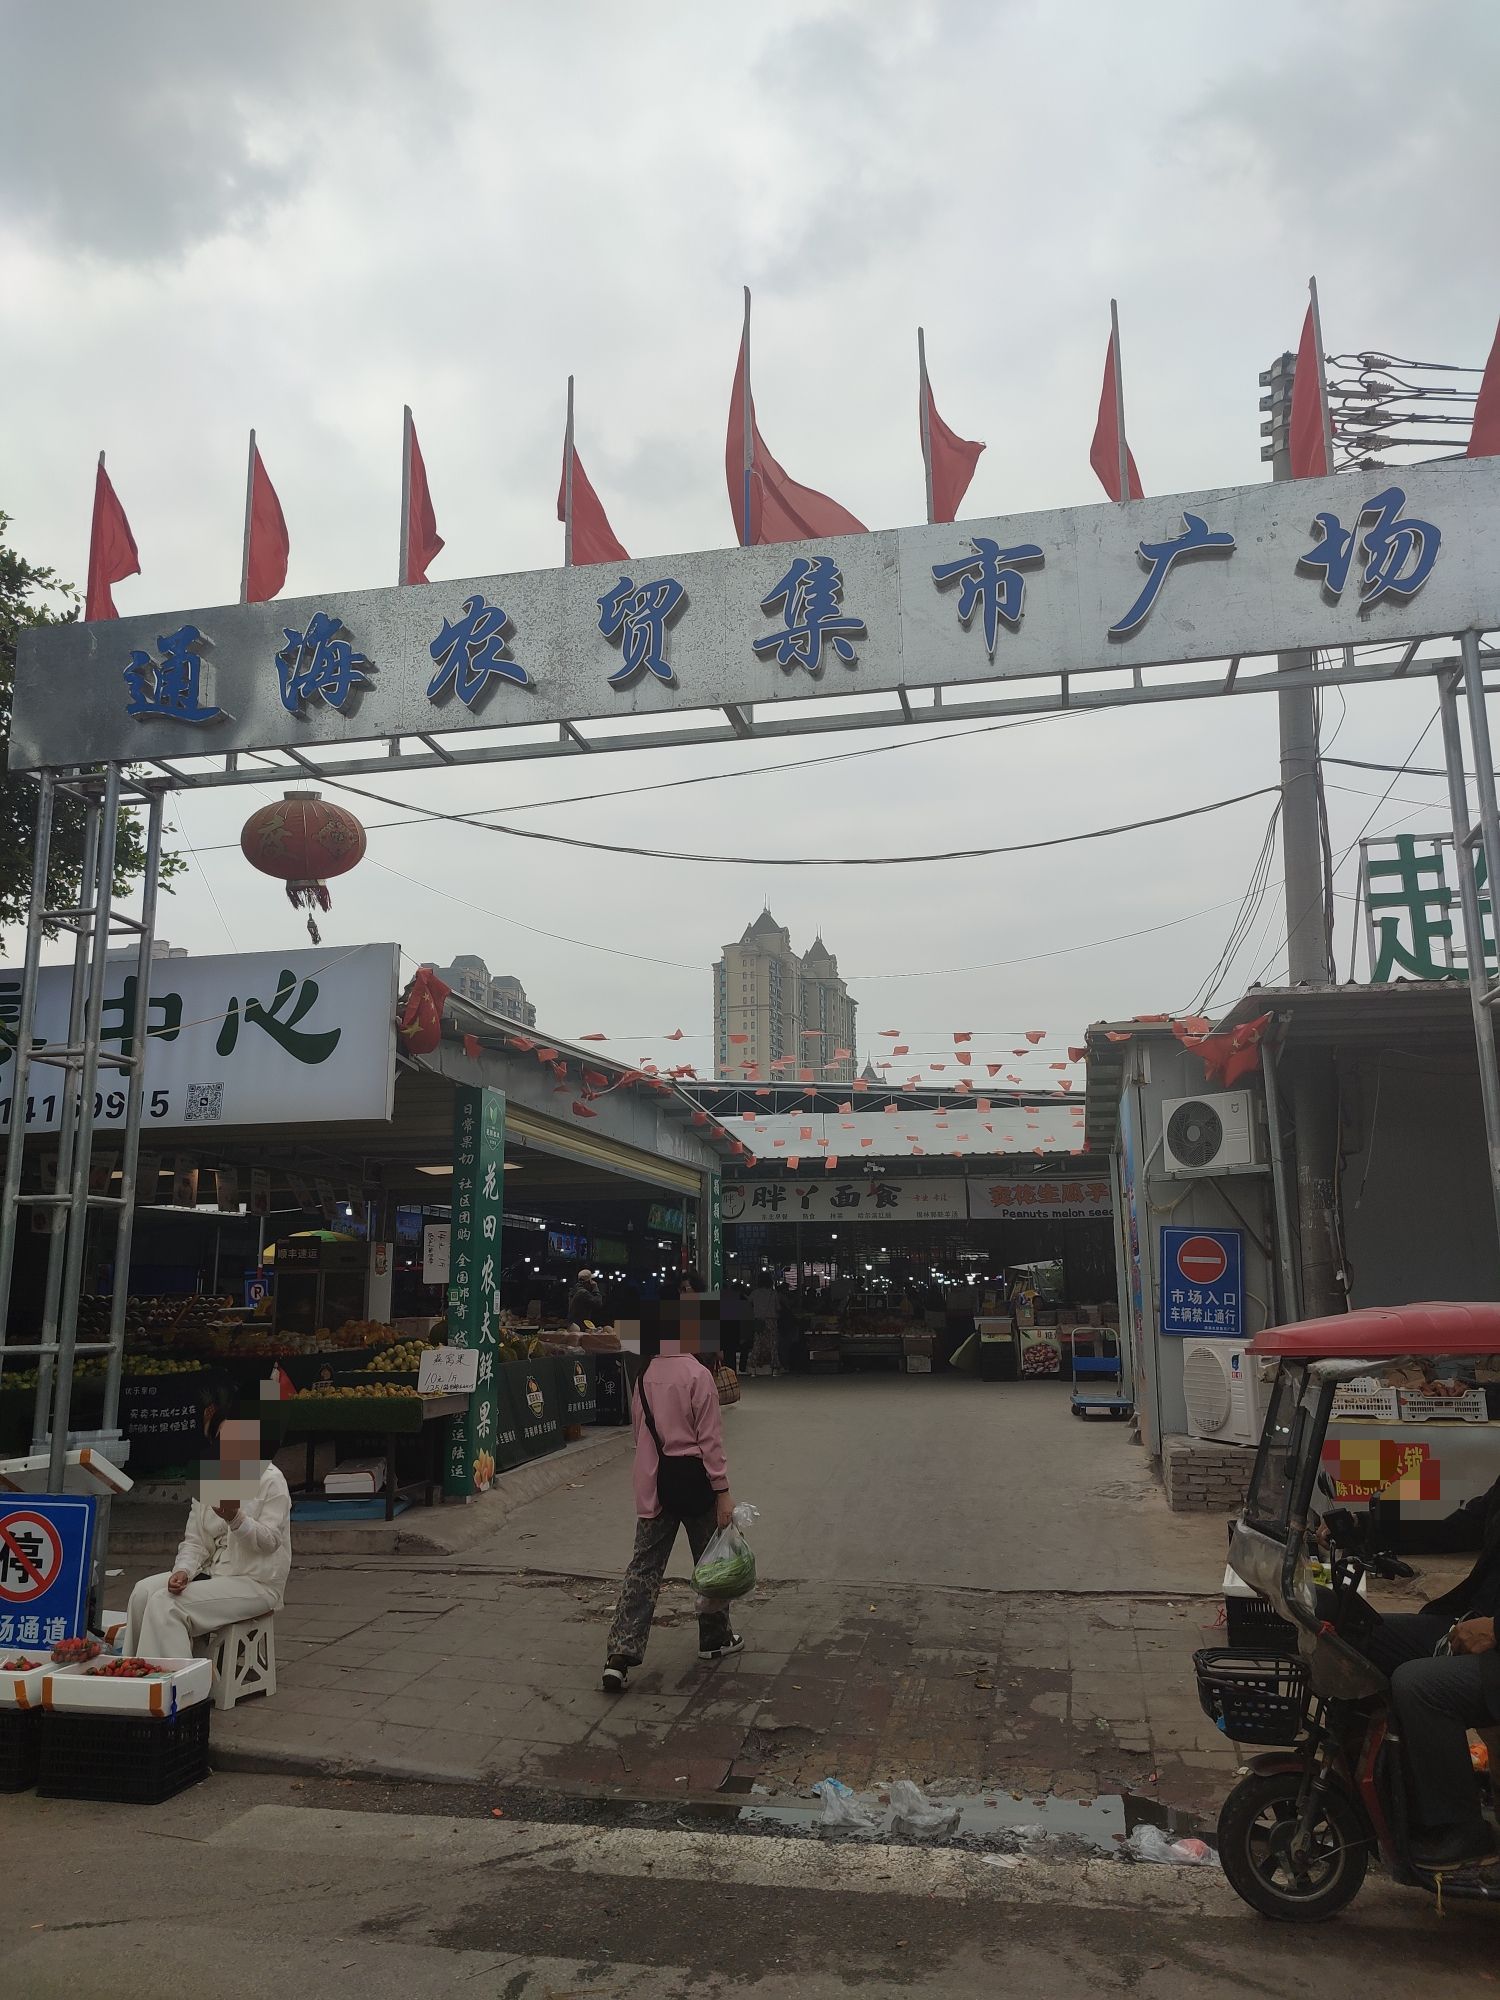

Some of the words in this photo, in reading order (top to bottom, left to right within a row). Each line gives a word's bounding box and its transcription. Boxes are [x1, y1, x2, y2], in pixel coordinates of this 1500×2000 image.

[123, 486, 1442, 723] 通海农贸集市广场
[459, 1103, 475, 1166] 日常果切
[456, 1178, 473, 1241] 社区团购
[752, 1183, 902, 1212] 胖丫面食
[1002, 1208, 1049, 1218] Peanuts
[1052, 1207, 1086, 1217] melon
[277, 1248, 319, 1259] 顺丰速运
[477, 1160, 500, 1440] 花田农夫鲜果
[1170, 1289, 1236, 1306] 市场入口
[1170, 1307, 1236, 1325] 车辆禁止通行
